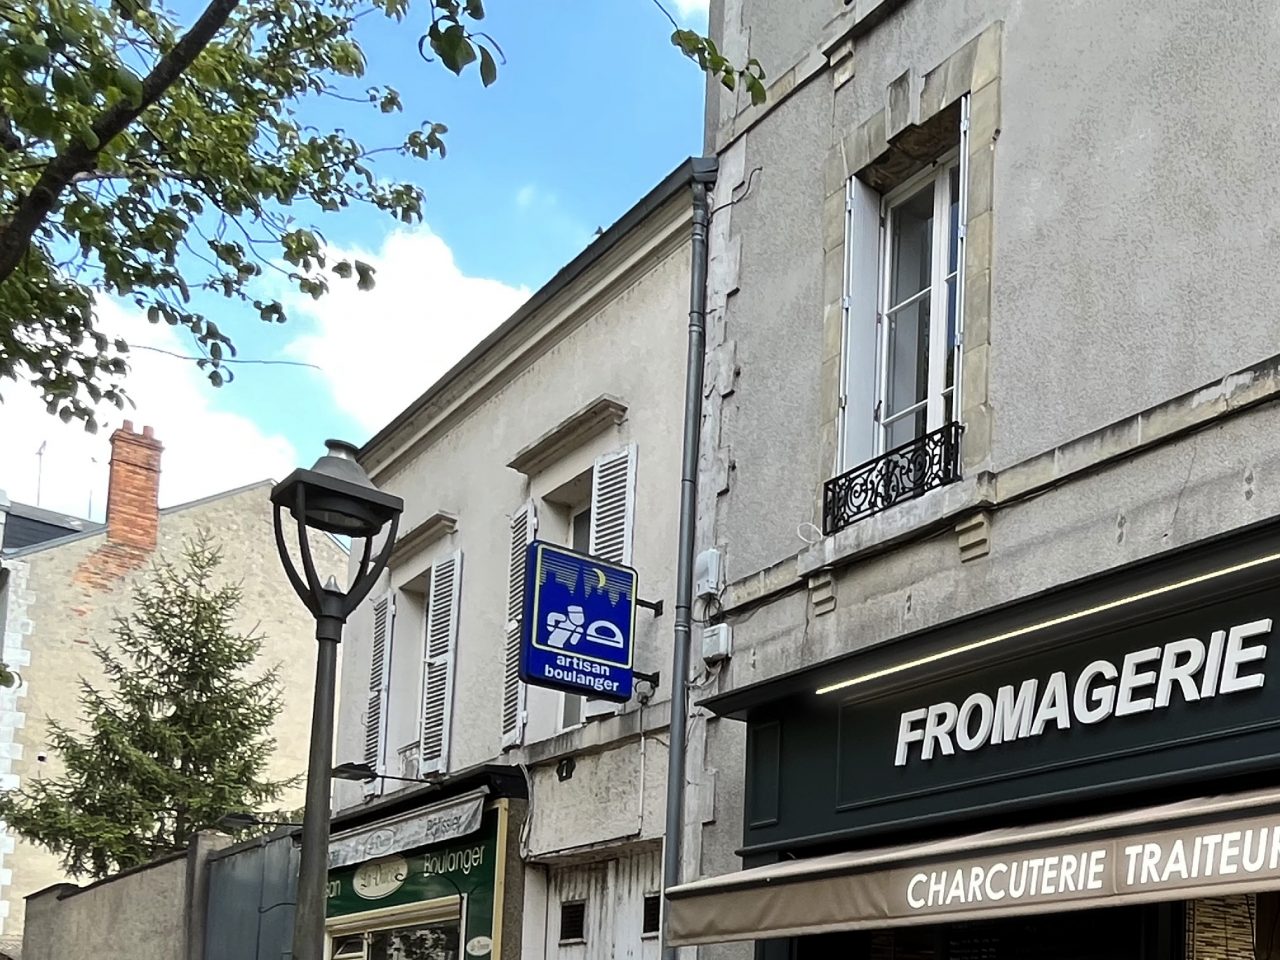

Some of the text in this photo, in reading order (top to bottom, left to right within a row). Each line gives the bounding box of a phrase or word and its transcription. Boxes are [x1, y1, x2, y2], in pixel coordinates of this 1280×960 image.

[544, 664, 620, 692] boulanger
[556, 655, 610, 676] artisan
[894, 618, 1272, 767] FROMAGERIE
[423, 845, 485, 877] Boulanger
[905, 849, 1107, 909] CHARCUTERIE
